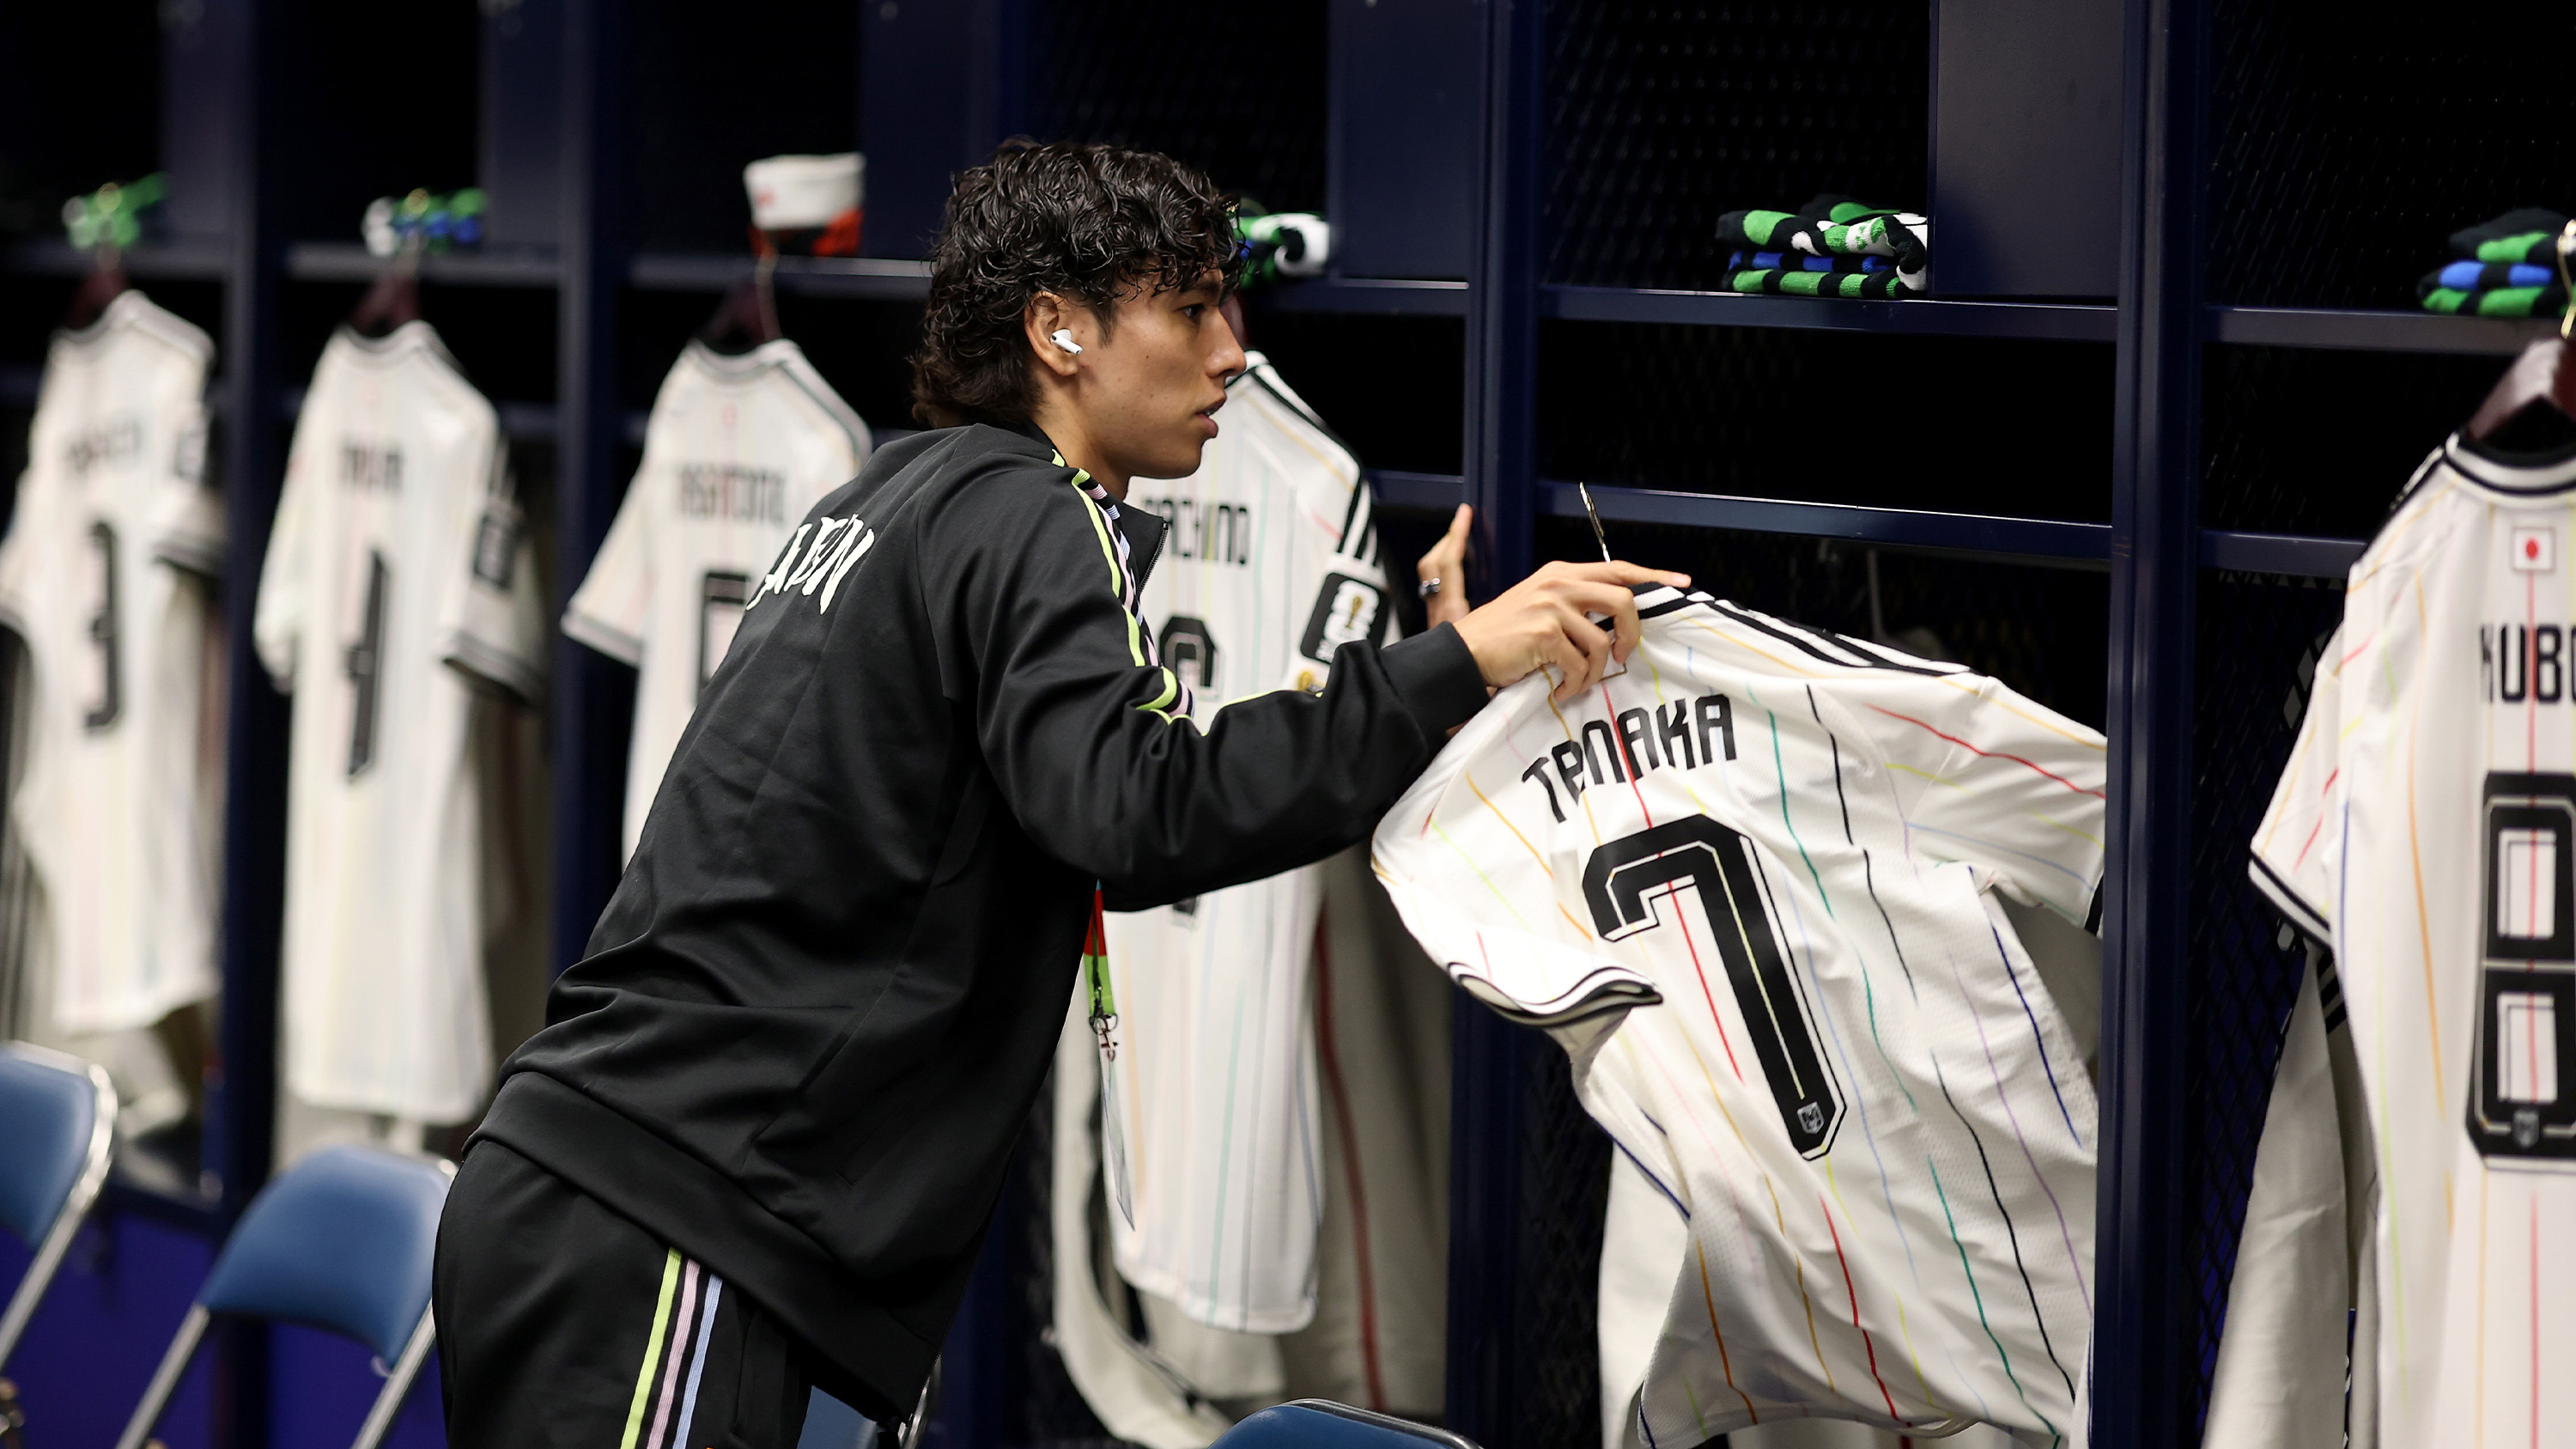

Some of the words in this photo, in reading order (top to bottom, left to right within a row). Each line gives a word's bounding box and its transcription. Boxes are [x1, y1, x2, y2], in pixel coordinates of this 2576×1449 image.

[1143, 496, 1251, 569] ACHINO
[1522, 693, 1737, 823] TANAKA
[1582, 813, 1847, 1161] 7
[2465, 770, 2576, 1161] 8
